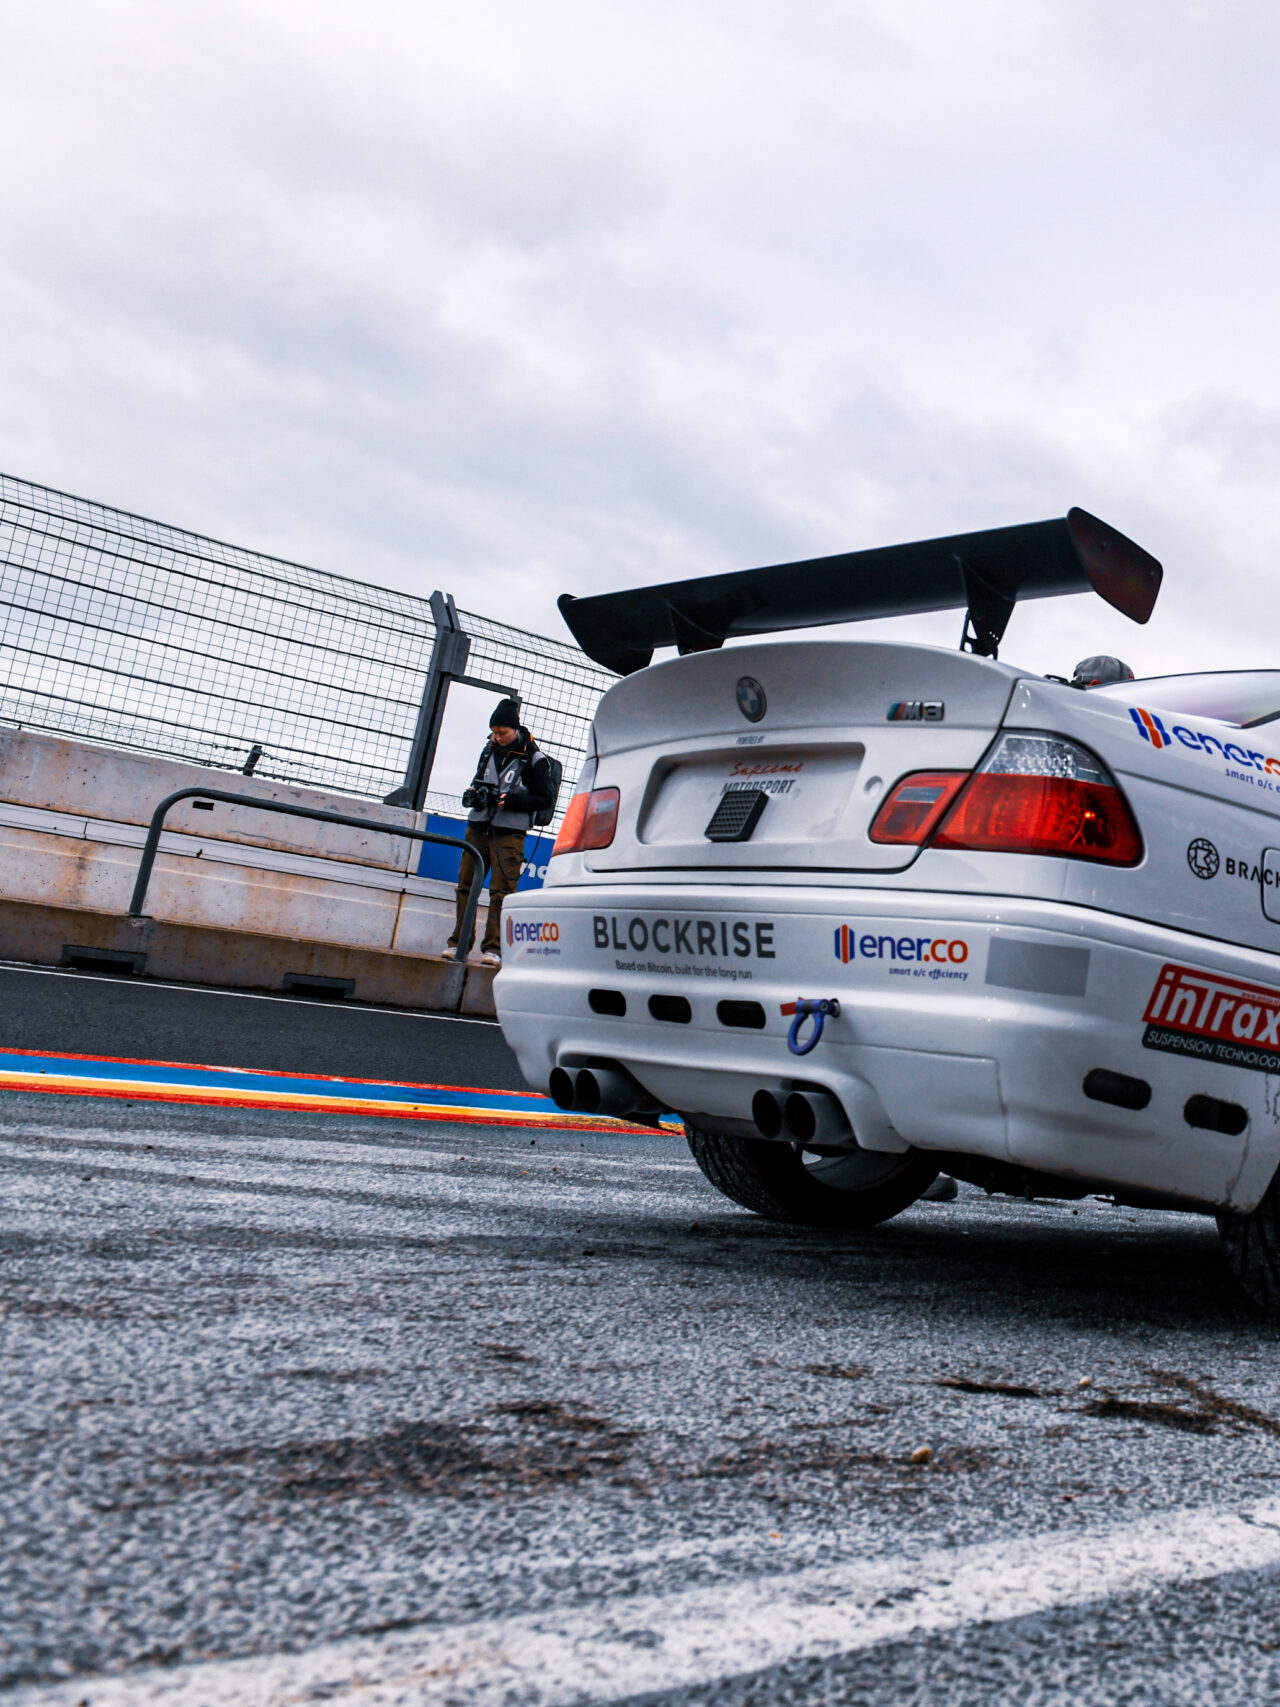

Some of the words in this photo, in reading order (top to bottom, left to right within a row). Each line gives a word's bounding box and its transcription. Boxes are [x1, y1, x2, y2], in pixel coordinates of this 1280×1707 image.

[729, 762, 804, 780] Supreme
[1225, 768, 1254, 784] smart
[1257, 777, 1273, 791] a/c
[514, 921, 559, 943] ener.co
[593, 916, 776, 959] BLOCKRISE
[859, 934, 969, 964] ener.co
[615, 959, 636, 971] Based
[636, 963, 647, 972] on
[647, 962, 675, 975] Bitcoin,
[674, 964, 692, 975] built
[692, 965, 704, 976] for
[704, 966, 718, 977] the
[717, 967, 738, 981] long
[738, 970, 753, 980] run
[888, 967, 911, 976] smart
[913, 967, 926, 977] a/c
[928, 969, 969, 981] efficiency
[1147, 1030, 1213, 1054] SUSPENSION
